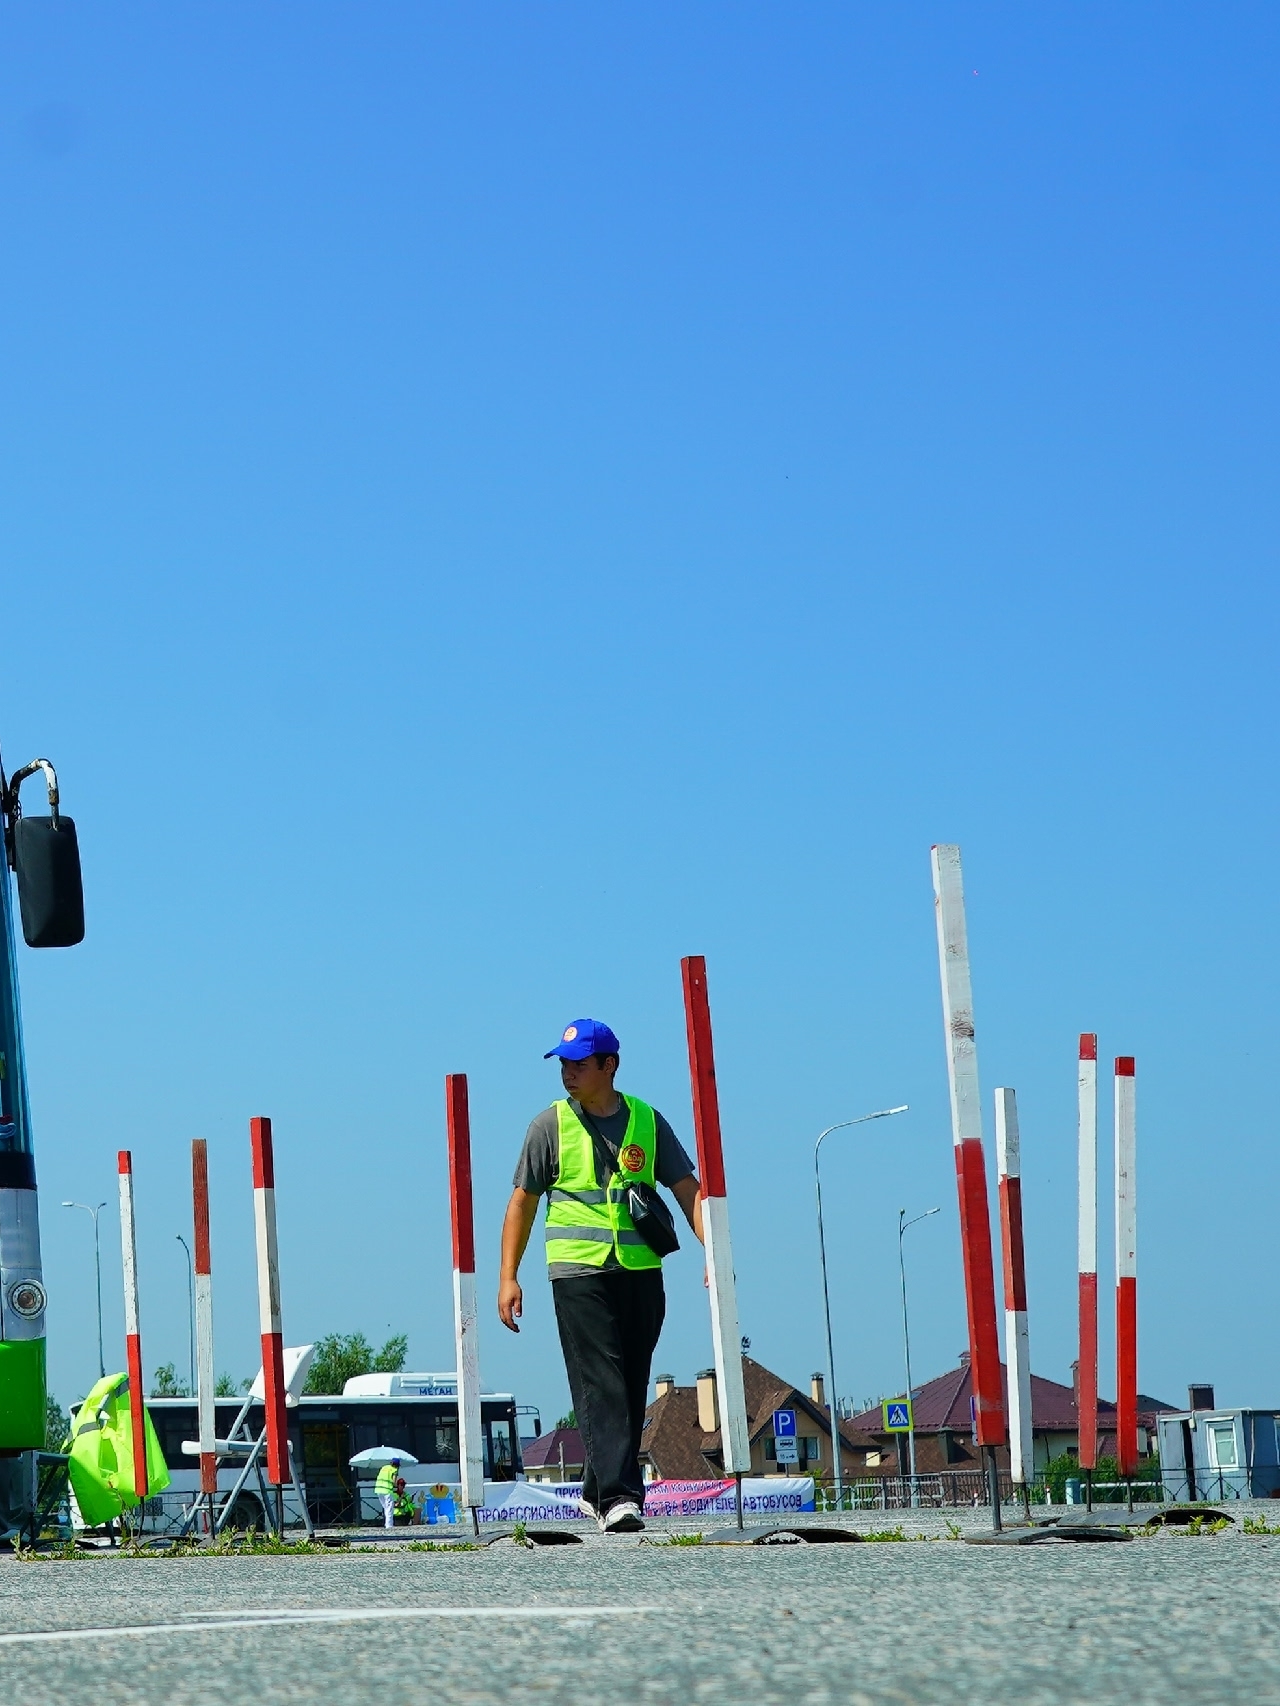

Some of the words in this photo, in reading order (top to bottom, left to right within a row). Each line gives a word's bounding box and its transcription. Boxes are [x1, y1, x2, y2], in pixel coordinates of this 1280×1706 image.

[778, 1412, 791, 1435] P
[555, 1487, 583, 1499] ПРИВ
[742, 1494, 802, 1512] АВТОБУСОВ
